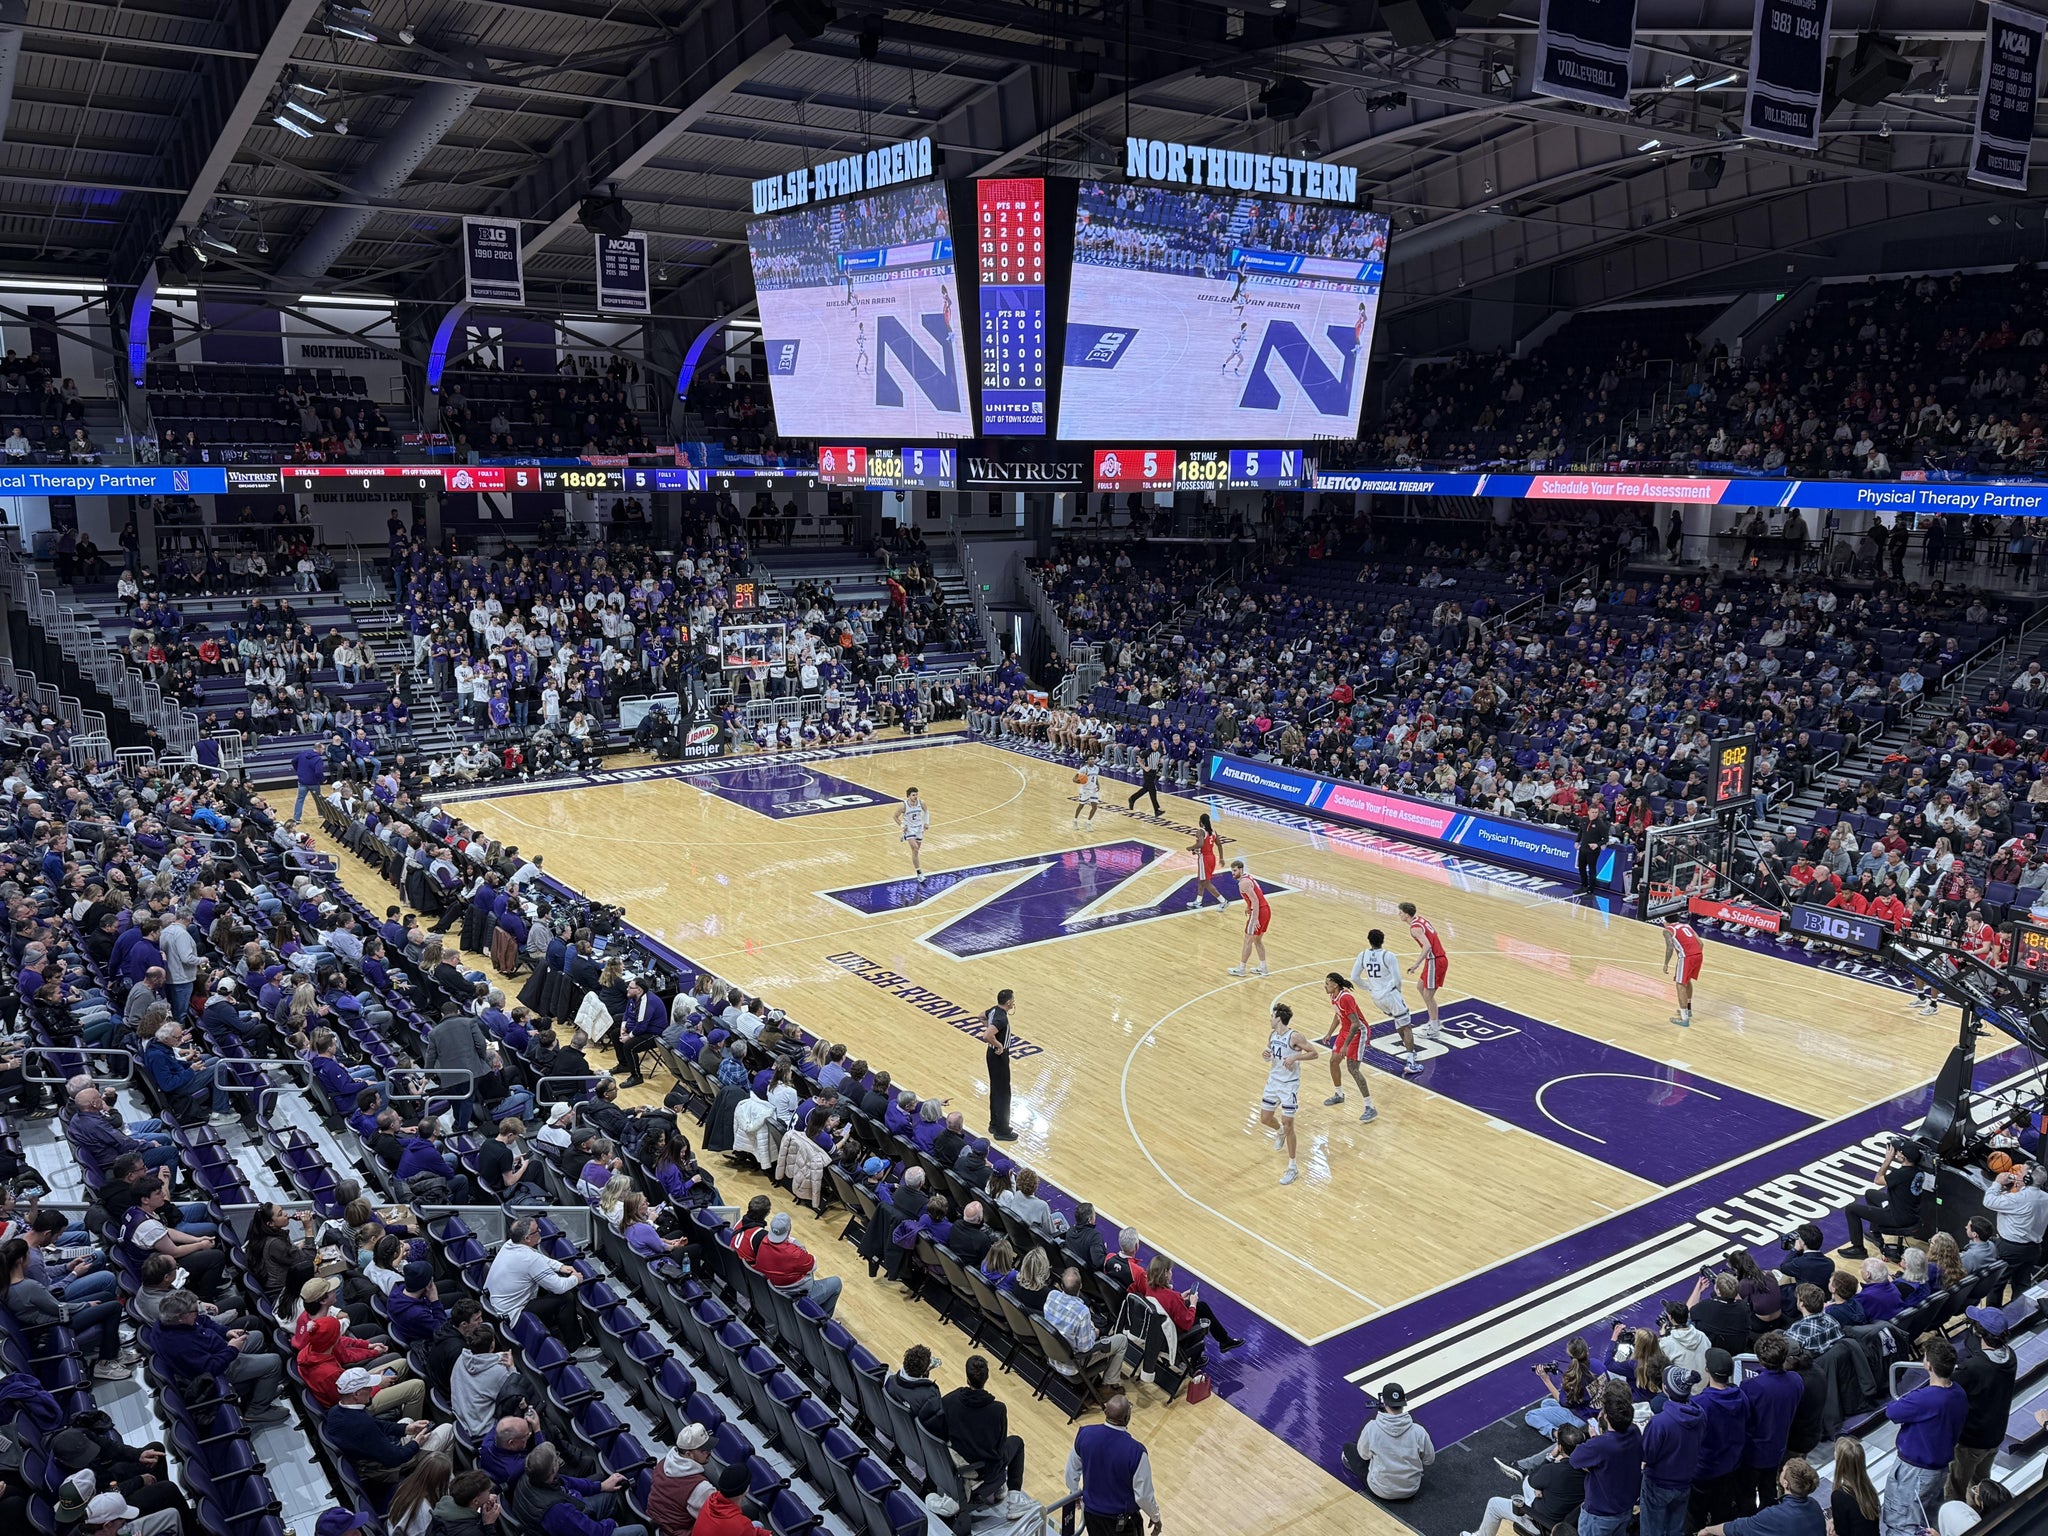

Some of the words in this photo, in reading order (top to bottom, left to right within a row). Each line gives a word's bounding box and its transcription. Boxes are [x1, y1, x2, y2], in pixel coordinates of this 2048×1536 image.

[1770, 9, 1792, 34] 1983
[1795, 16, 1820, 40] 1984
[1557, 59, 1616, 88] VOLLEYBALL
[1764, 105, 1808, 128] VOLLEYBALL
[752, 154, 863, 214] WELSH-RYAN
[866, 136, 932, 190] ARENA
[1126, 137, 1358, 202] NORTHWESTERN
[996, 202, 1010, 210] PTS
[1015, 202, 1026, 210] RB
[1034, 202, 1040, 210] F
[984, 213, 991, 222] 0
[1000, 213, 1007, 222] 2
[1017, 213, 1023, 222] 1
[1034, 213, 1040, 222] 0
[984, 228, 991, 237] 2
[1000, 228, 1007, 237] 2
[1017, 228, 1024, 237] 0
[1034, 228, 1040, 237] 0
[608, 240, 636, 251] NCAA
[982, 242, 993, 252] 13
[1001, 242, 1008, 252] 0
[1017, 242, 1024, 252] 0
[1034, 242, 1040, 252] 0
[474, 249, 492, 258] 1990
[494, 251, 513, 260] 2020
[982, 258, 994, 267] 14
[1001, 258, 1008, 267] 0
[1017, 258, 1024, 267] 0
[1034, 258, 1040, 267] 0
[982, 272, 994, 282] 21
[1001, 272, 1008, 282] 0
[1018, 272, 1024, 282] 0
[1034, 272, 1041, 282] 0
[1314, 281, 1337, 291] BIG
[1339, 283, 1372, 294] TEN
[986, 320, 992, 330] 2
[1002, 320, 1008, 330] 2
[1018, 320, 1025, 330] 0
[1034, 320, 1041, 330] 0
[986, 334, 993, 344] 4
[1002, 334, 1009, 344] 0
[1019, 334, 1024, 344] 1
[1035, 334, 1040, 344] 1
[984, 348, 995, 358] 11
[1002, 348, 1008, 358] 3
[1019, 348, 1025, 358] 0
[1035, 348, 1041, 358] 0
[984, 363, 996, 372] 22
[1003, 363, 1010, 372] 0
[1020, 363, 1024, 372] 1
[1035, 363, 1041, 372] 0
[984, 377, 996, 386] 44
[1003, 377, 1010, 386] 0
[1019, 377, 1026, 386] 0
[1035, 377, 1042, 386] 0
[985, 415, 996, 423] OUT
[997, 415, 1004, 423] OF
[1005, 415, 1022, 423] TOWN
[1022, 415, 1043, 423] SCORES
[847, 450, 856, 472] 5
[914, 450, 923, 475] 5
[1190, 452, 1200, 460] 1ST
[1201, 452, 1218, 461] HALF
[868, 458, 901, 477] 18:02
[939, 450, 950, 477] N
[968, 458, 1084, 480] WINTRUST
[1143, 453, 1158, 477] 5
[1246, 453, 1258, 476] 5
[1280, 451, 1294, 477] N
[228, 472, 277, 482] WINTRUST
[1178, 461, 1227, 480] 18:02
[30, 474, 95, 490] Therapy
[100, 474, 156, 487] Partner
[173, 471, 189, 491] N
[305, 479, 311, 488] 0
[363, 479, 369, 488] 0
[419, 479, 426, 488] 0
[517, 473, 527, 486] 5
[560, 472, 607, 486] 18:02
[635, 473, 646, 486] 5
[687, 470, 700, 490] N
[723, 480, 728, 488] 0
[767, 480, 772, 488] 0
[809, 480, 814, 488] 0
[868, 478, 894, 486] POSSESSION
[1177, 481, 1214, 490] POSSESSION
[1362, 481, 1397, 492] PHYSICAL
[1398, 481, 1434, 492] THERAPY
[1542, 480, 1589, 495] Schedule
[1591, 482, 1614, 495] Your
[1616, 482, 1630, 496] Free
[1632, 483, 1711, 499] Assessment
[1857, 489, 1915, 507] Physical
[1919, 490, 1981, 509] Therapy
[1983, 493, 2041, 508] Partner
[735, 584, 754, 593] 18:02
[735, 593, 752, 608] 27
[698, 699, 705, 710] N
[686, 726, 715, 746] LIBMAN
[685, 742, 720, 757] meijer
[1723, 746, 1746, 766] 18:02
[587, 749, 842, 783] NORTHWESTERN
[1222, 766, 1260, 784] ATHLETICO
[1260, 779, 1281, 790] PHYSICAL
[1281, 783, 1301, 794] THERAPY
[1720, 767, 1742, 799] 27
[1334, 794, 1366, 810] Schedule
[1366, 801, 1381, 814] Your
[1382, 807, 1397, 817] Free
[1398, 811, 1443, 829] Assessment
[1478, 829, 1508, 844] Physical
[1510, 837, 1540, 853] Therapy
[1541, 844, 1570, 859] Partner
[1682, 928, 1692, 937] 0
[1367, 964, 1381, 978] 22
[826, 951, 969, 1020] WELSH-RYAN
[950, 1012, 1044, 1060] ARNA
